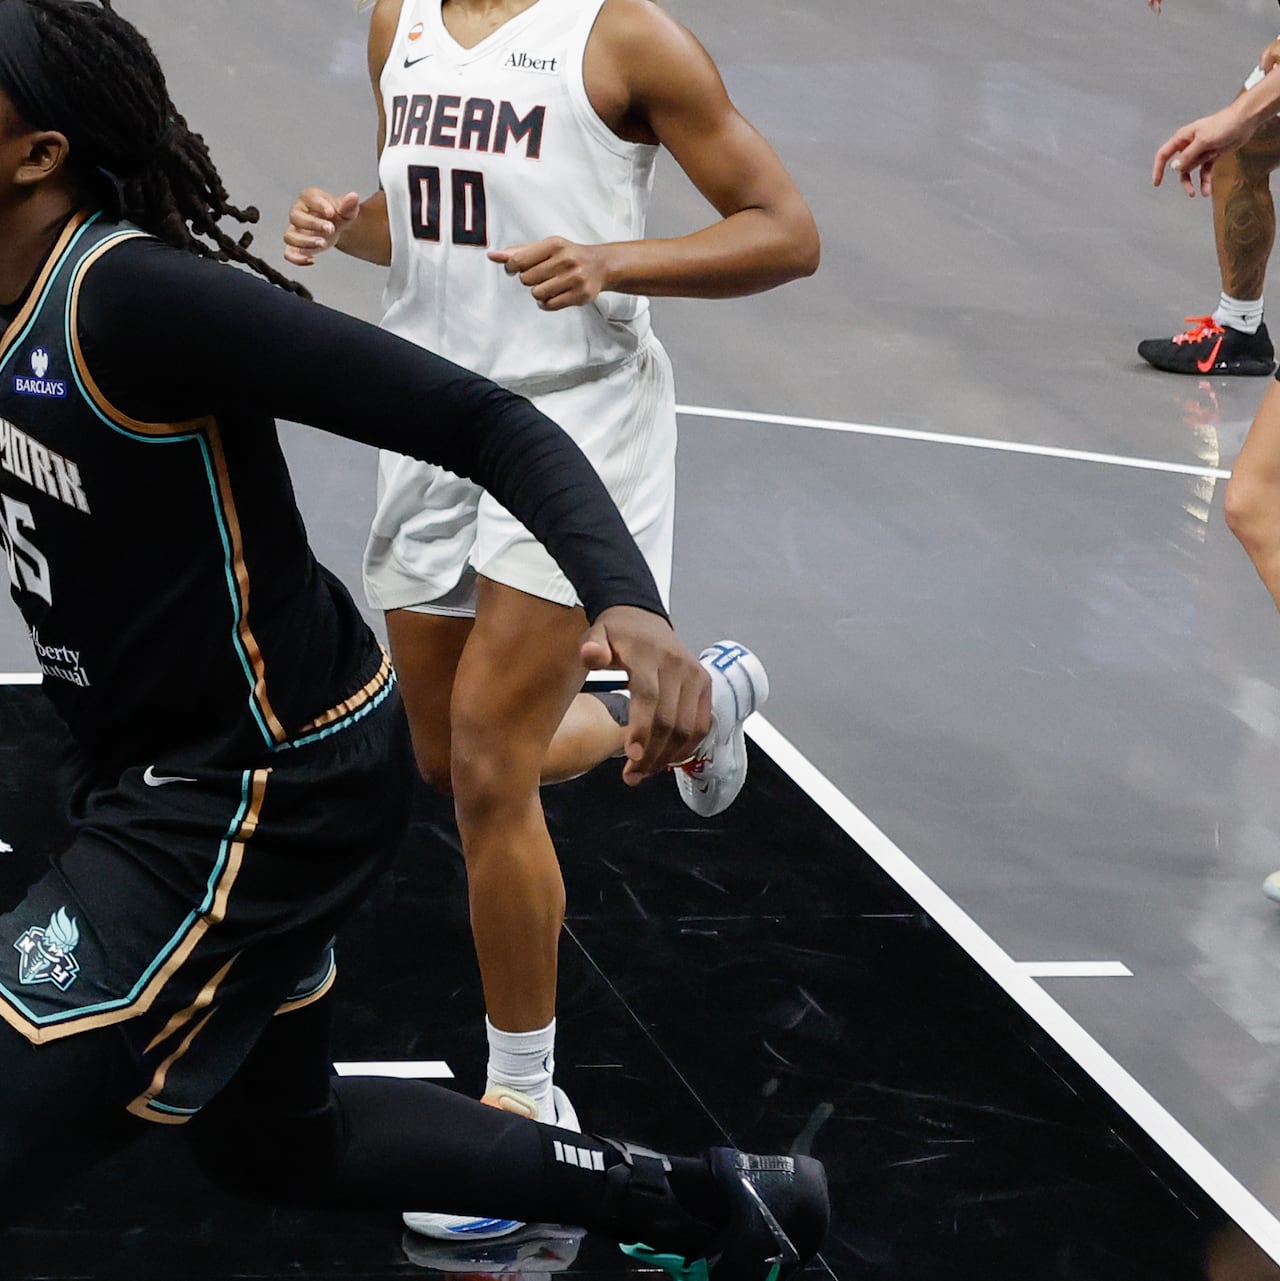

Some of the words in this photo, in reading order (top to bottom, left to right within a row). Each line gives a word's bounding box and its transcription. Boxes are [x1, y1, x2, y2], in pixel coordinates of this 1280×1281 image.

[504, 52, 558, 72] Albert
[388, 94, 547, 160] DREAM
[407, 164, 488, 247] 00
[15, 378, 65, 395] BARCLAYS
[36, 640, 82, 671] berty
